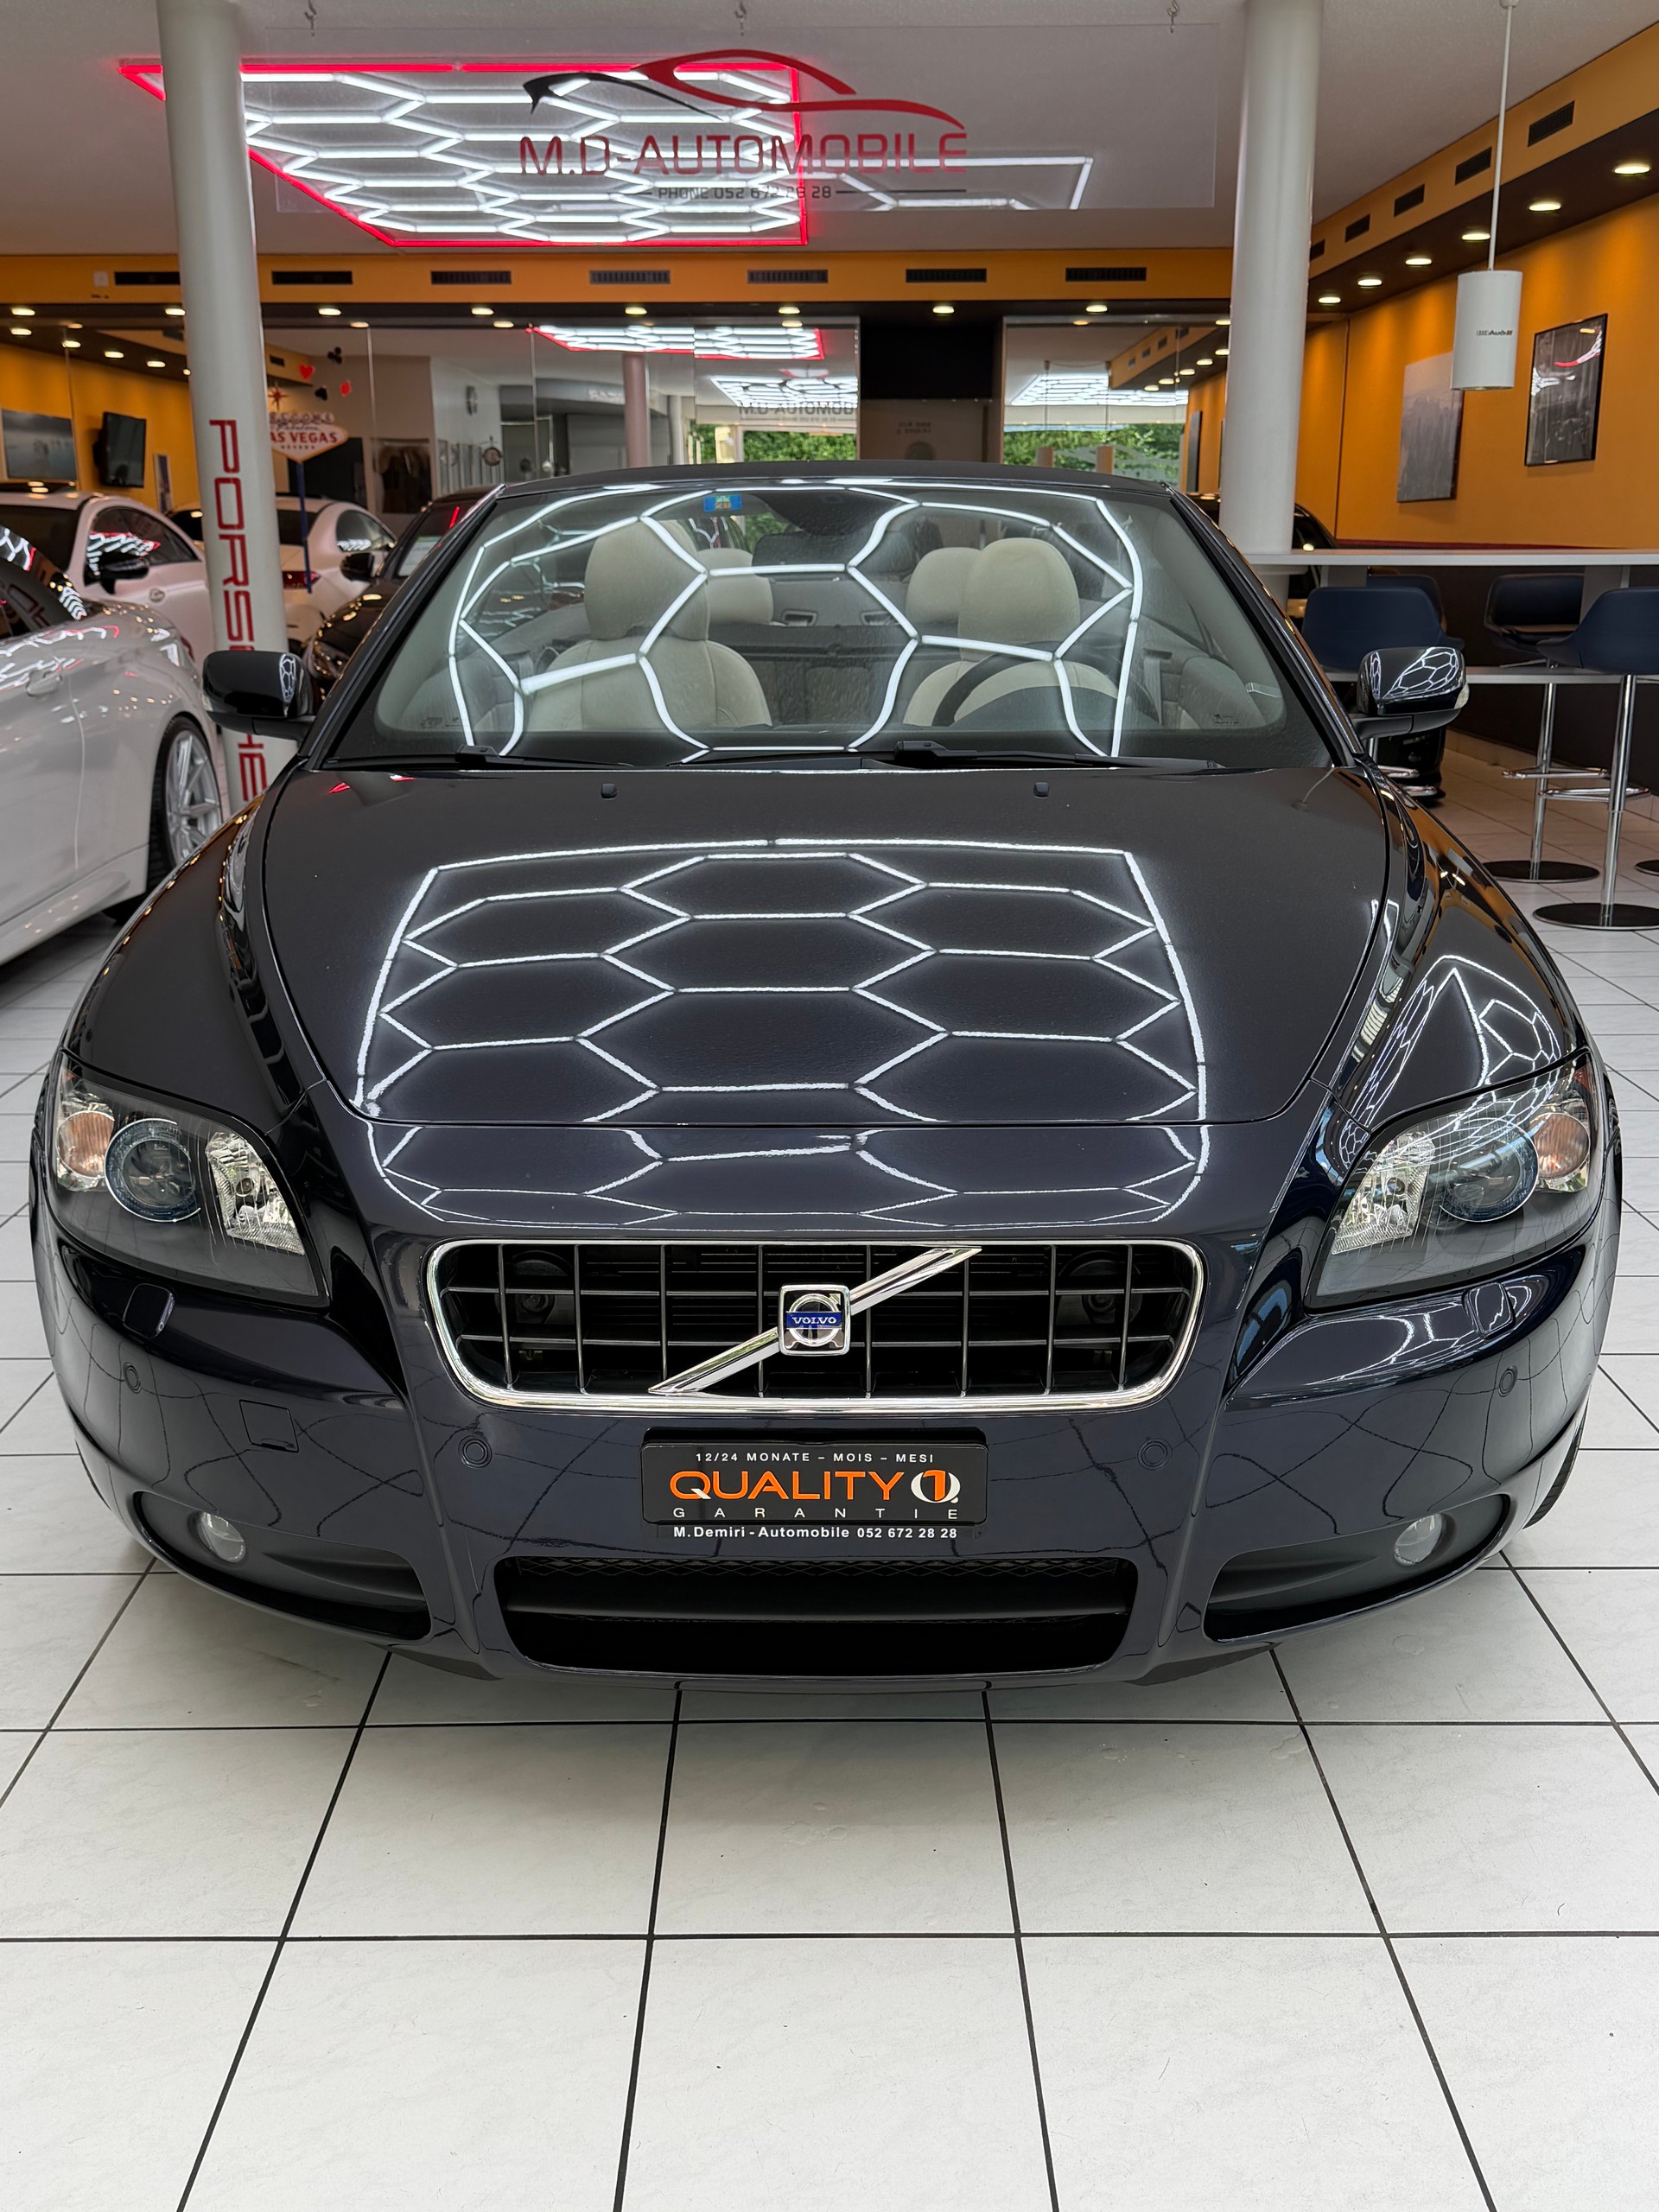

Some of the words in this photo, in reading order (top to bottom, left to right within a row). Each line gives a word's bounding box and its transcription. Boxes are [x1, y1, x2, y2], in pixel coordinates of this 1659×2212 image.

[519, 132, 967, 175] M.D-AUTOMOBILE
[714, 187, 744, 200] 052
[811, 186, 831, 199] 28
[289, 431, 338, 444] VEGAS
[208, 419, 268, 802] PORSE
[791, 1316, 837, 1325] VOLVO
[696, 1452, 738, 1462] 12/24
[747, 1452, 810, 1462] MONATE
[833, 1452, 873, 1463] MOIS
[895, 1453, 933, 1463] MESI
[669, 1471, 905, 1501] QUALITY
[672, 1507, 958, 1520] GARANTIE
[758, 1526, 849, 1538] Automobile
[857, 1527, 882, 1538] 052
[887, 1527, 913, 1538] 672
[918, 1528, 935, 1539] 28
[940, 1528, 957, 1539] 28
